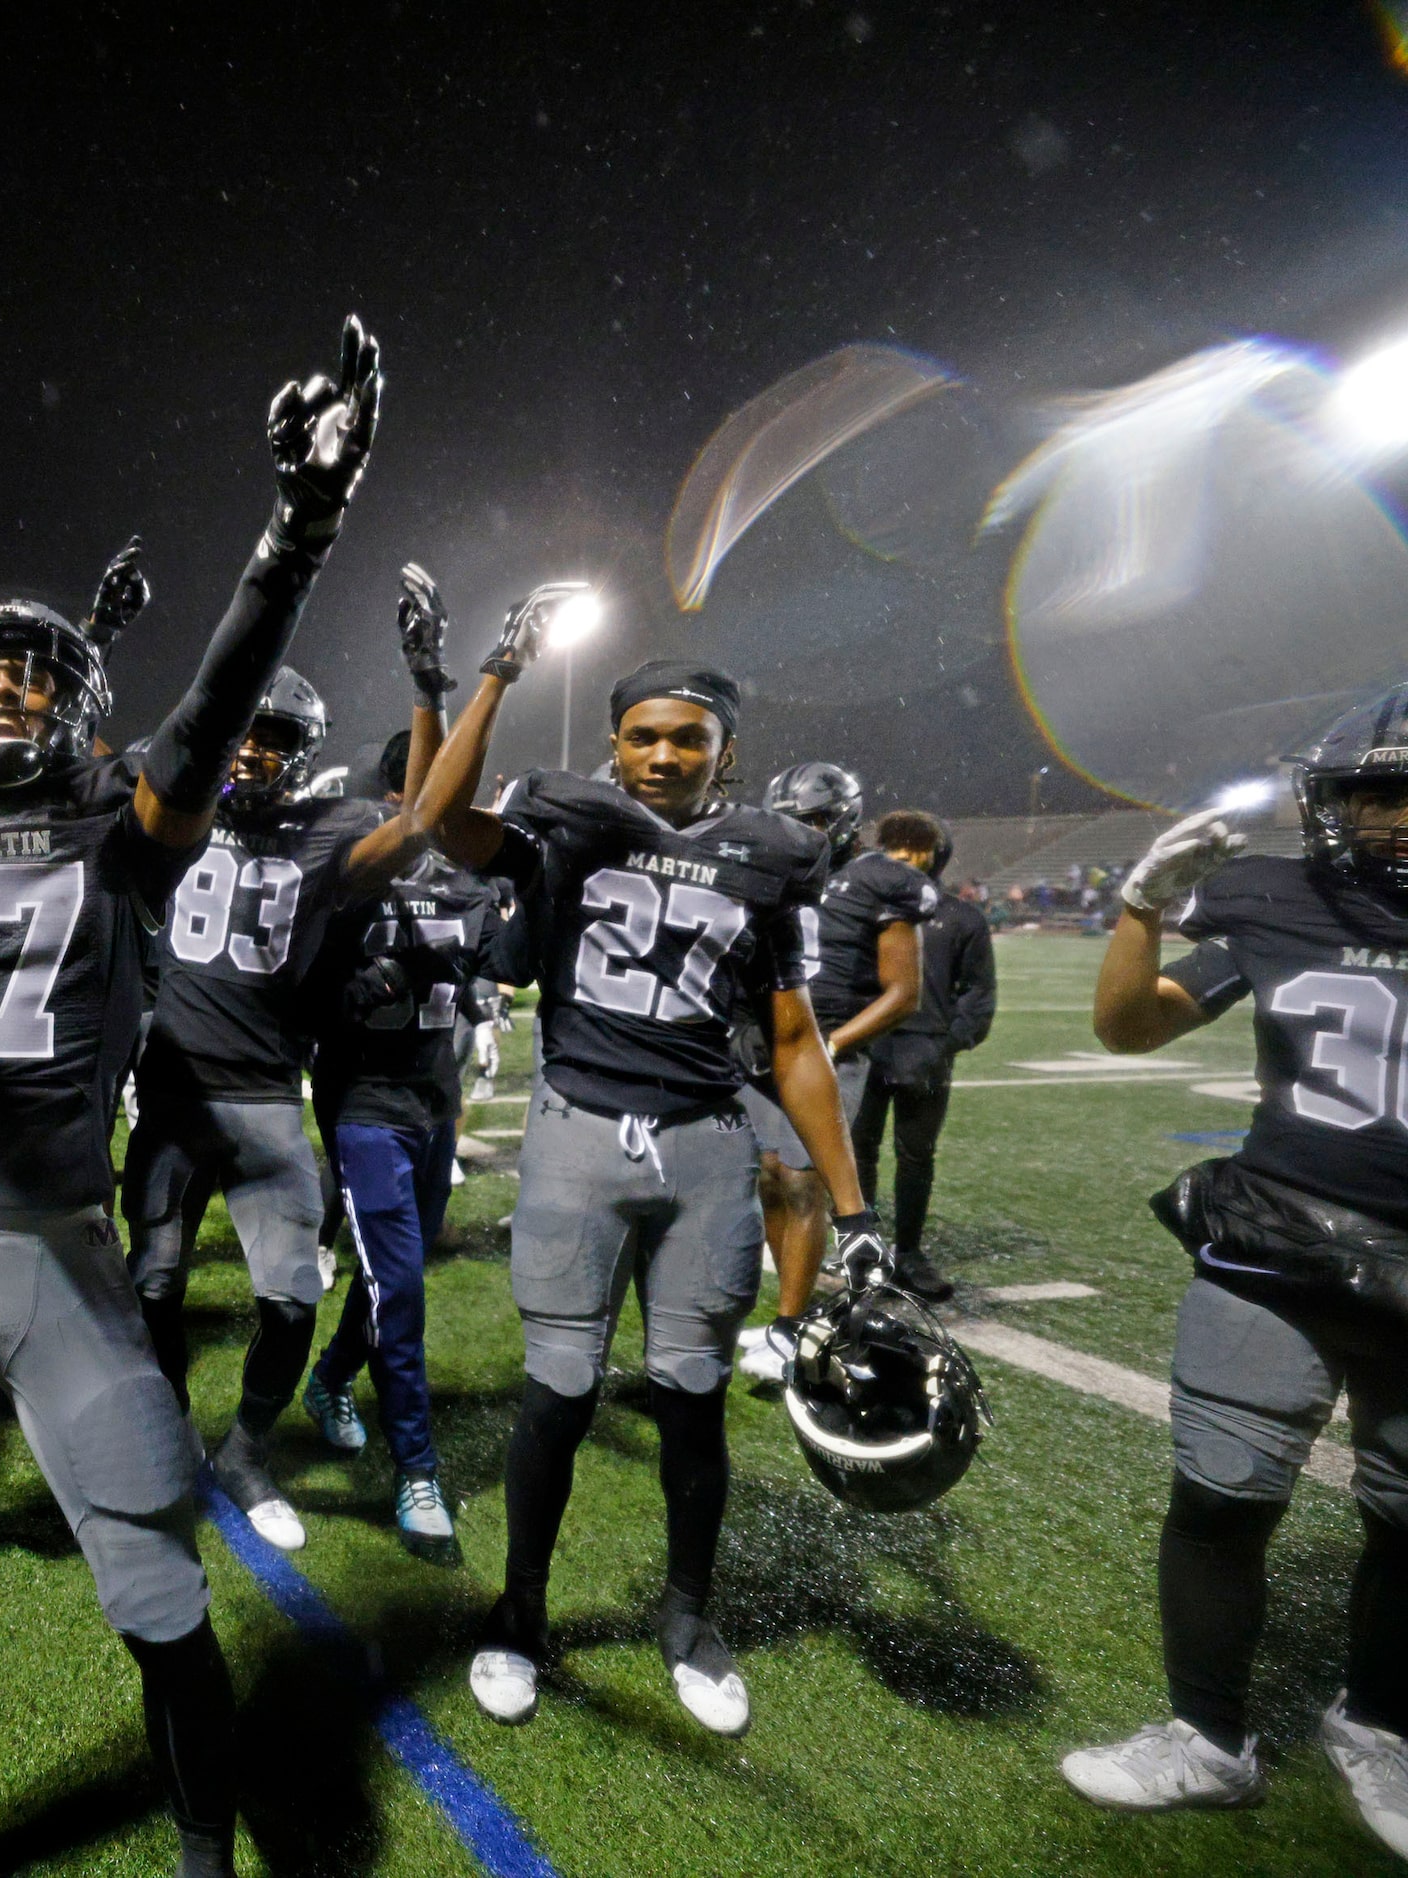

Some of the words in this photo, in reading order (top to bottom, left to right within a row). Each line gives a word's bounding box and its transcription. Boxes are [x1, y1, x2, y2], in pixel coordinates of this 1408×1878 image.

[169, 846, 304, 975] 83
[381, 900, 437, 916] MTIN
[626, 852, 719, 886] MARTIN
[574, 867, 746, 1024] 27
[1270, 970, 1408, 1131] 3
[801, 1432, 885, 1474] WARRIO
